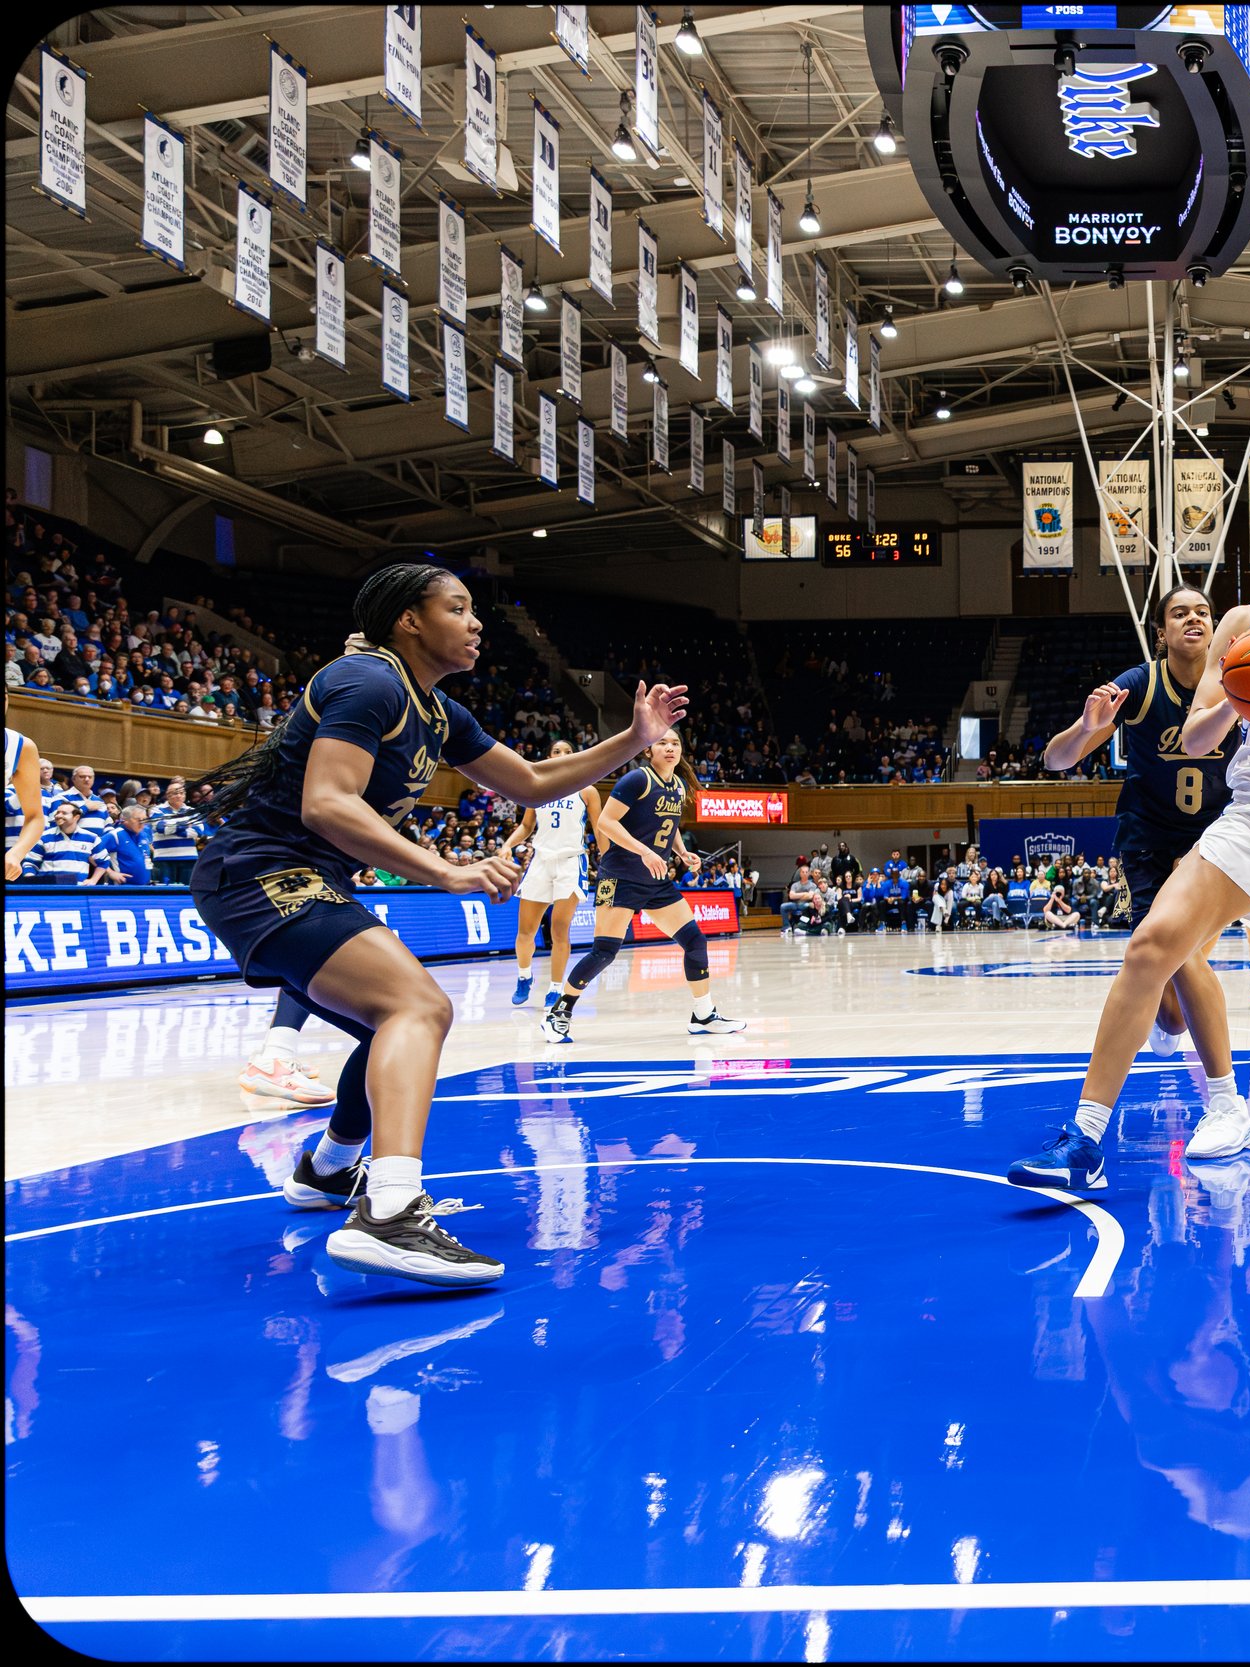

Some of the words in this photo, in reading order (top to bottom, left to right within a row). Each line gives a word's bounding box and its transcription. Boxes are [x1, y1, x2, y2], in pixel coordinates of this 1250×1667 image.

[1056, 5, 1084, 15] POSS
[397, 33, 413, 56] NCAA
[388, 42, 405, 67] FINAL
[54, 124, 75, 144] COAST
[1068, 212, 1143, 224] MARRIOTT
[1054, 226, 1158, 245] BONVOY
[1030, 475, 1067, 485] NATIONAL
[1025, 486, 1071, 497] CHAMPIONS
[1107, 485, 1146, 494] HAMPIONS
[836, 545, 851, 557] 56
[914, 544, 930, 556] 41
[1038, 546, 1059, 555] 1991
[1189, 542, 1211, 551] 2001
[893, 550, 900, 560] 3
[1176, 767, 1203, 815] 8
[655, 796, 682, 814] Irish
[702, 799, 725, 809] FAN
[727, 799, 763, 810] WORK
[551, 811, 560, 828] 3
[654, 818, 674, 848] 2
[1029, 844, 1071, 855] SISTERHOOD
